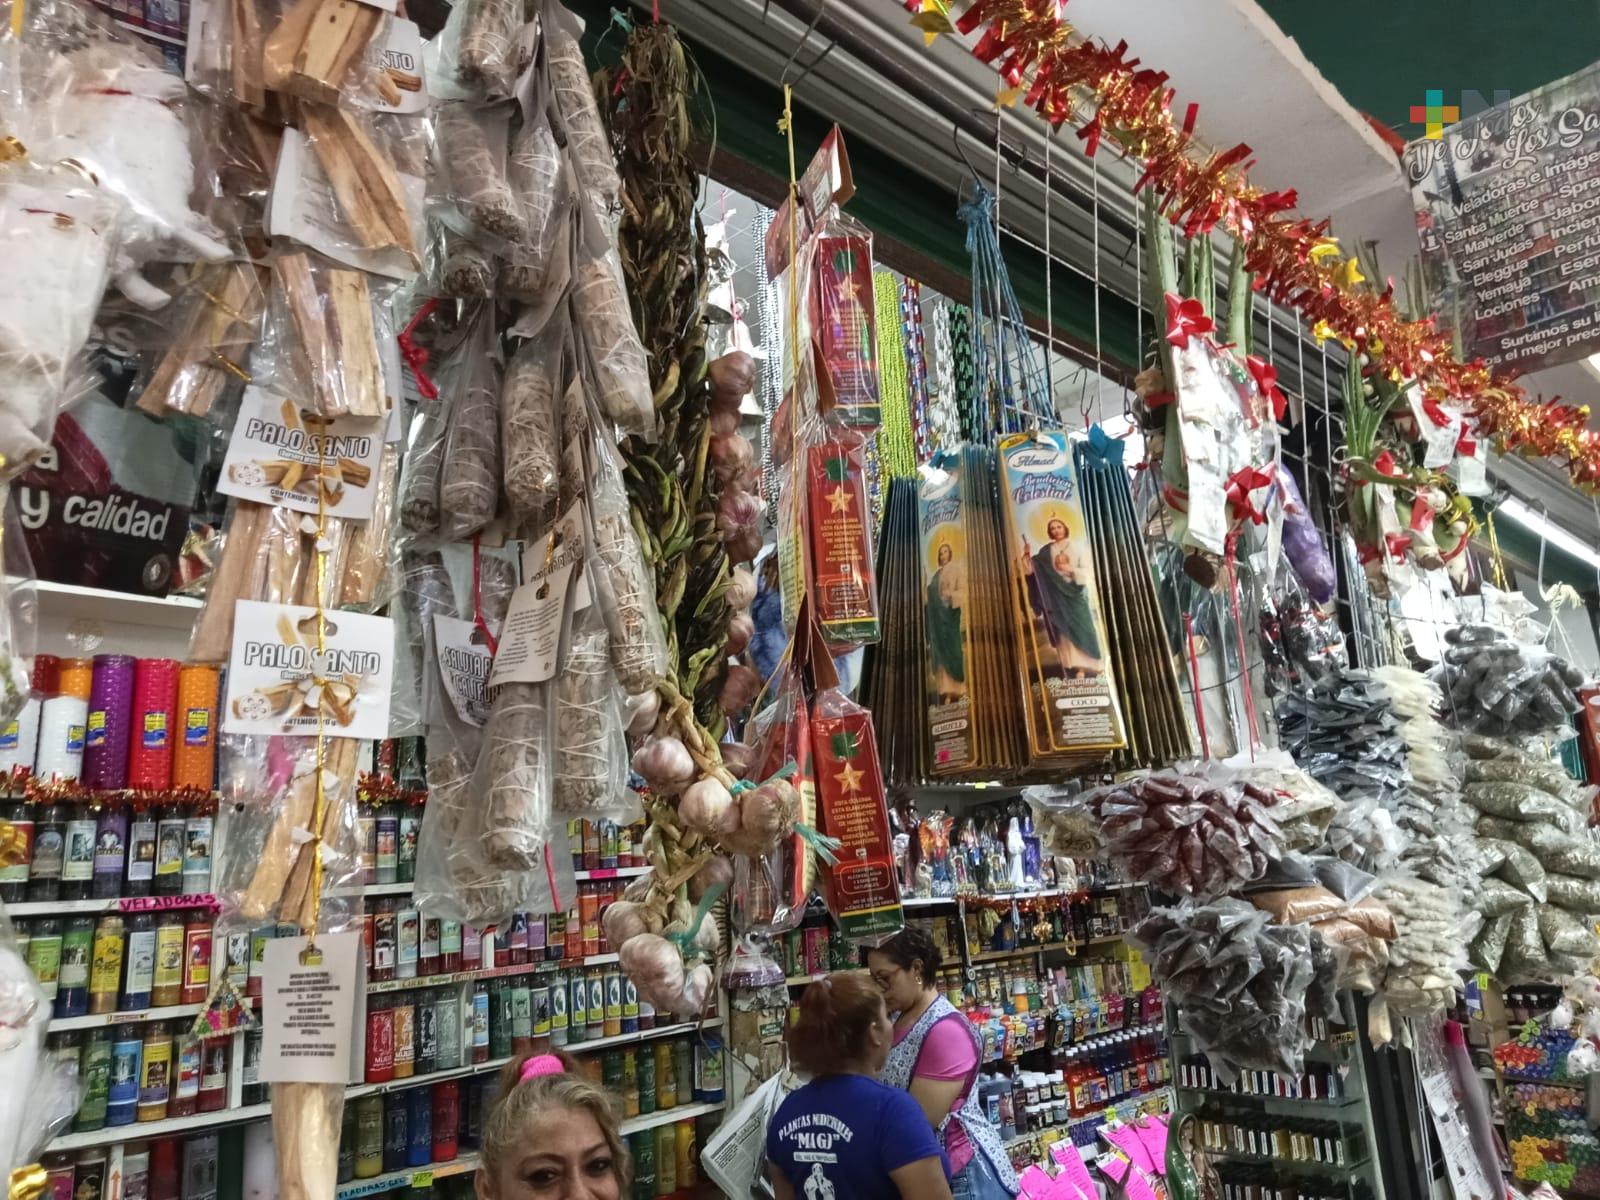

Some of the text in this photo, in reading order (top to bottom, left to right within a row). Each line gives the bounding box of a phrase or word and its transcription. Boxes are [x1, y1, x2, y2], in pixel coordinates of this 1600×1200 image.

[1502, 125, 1551, 170] Los
[1453, 176, 1529, 217] Veladoras
[1531, 171, 1542, 184] e
[1445, 199, 1540, 245] Santa Muerte
[1464, 223, 1525, 255] Malverde
[1473, 258, 1529, 287] Eleggua
[1476, 276, 1532, 302] Yemaya
[1474, 292, 1541, 321] Lociones
[1501, 323, 1569, 349] Surtimos
[1572, 316, 1591, 329] su
[1505, 349, 1518, 360] el
[1521, 338, 1562, 355] mejor
[245, 418, 371, 459] PALO SANTO
[20, 486, 172, 541] y calidad
[244, 641, 305, 669] PALO
[120, 894, 216, 911] VELADORAS
[778, 1114, 811, 1142] PLANTAS
